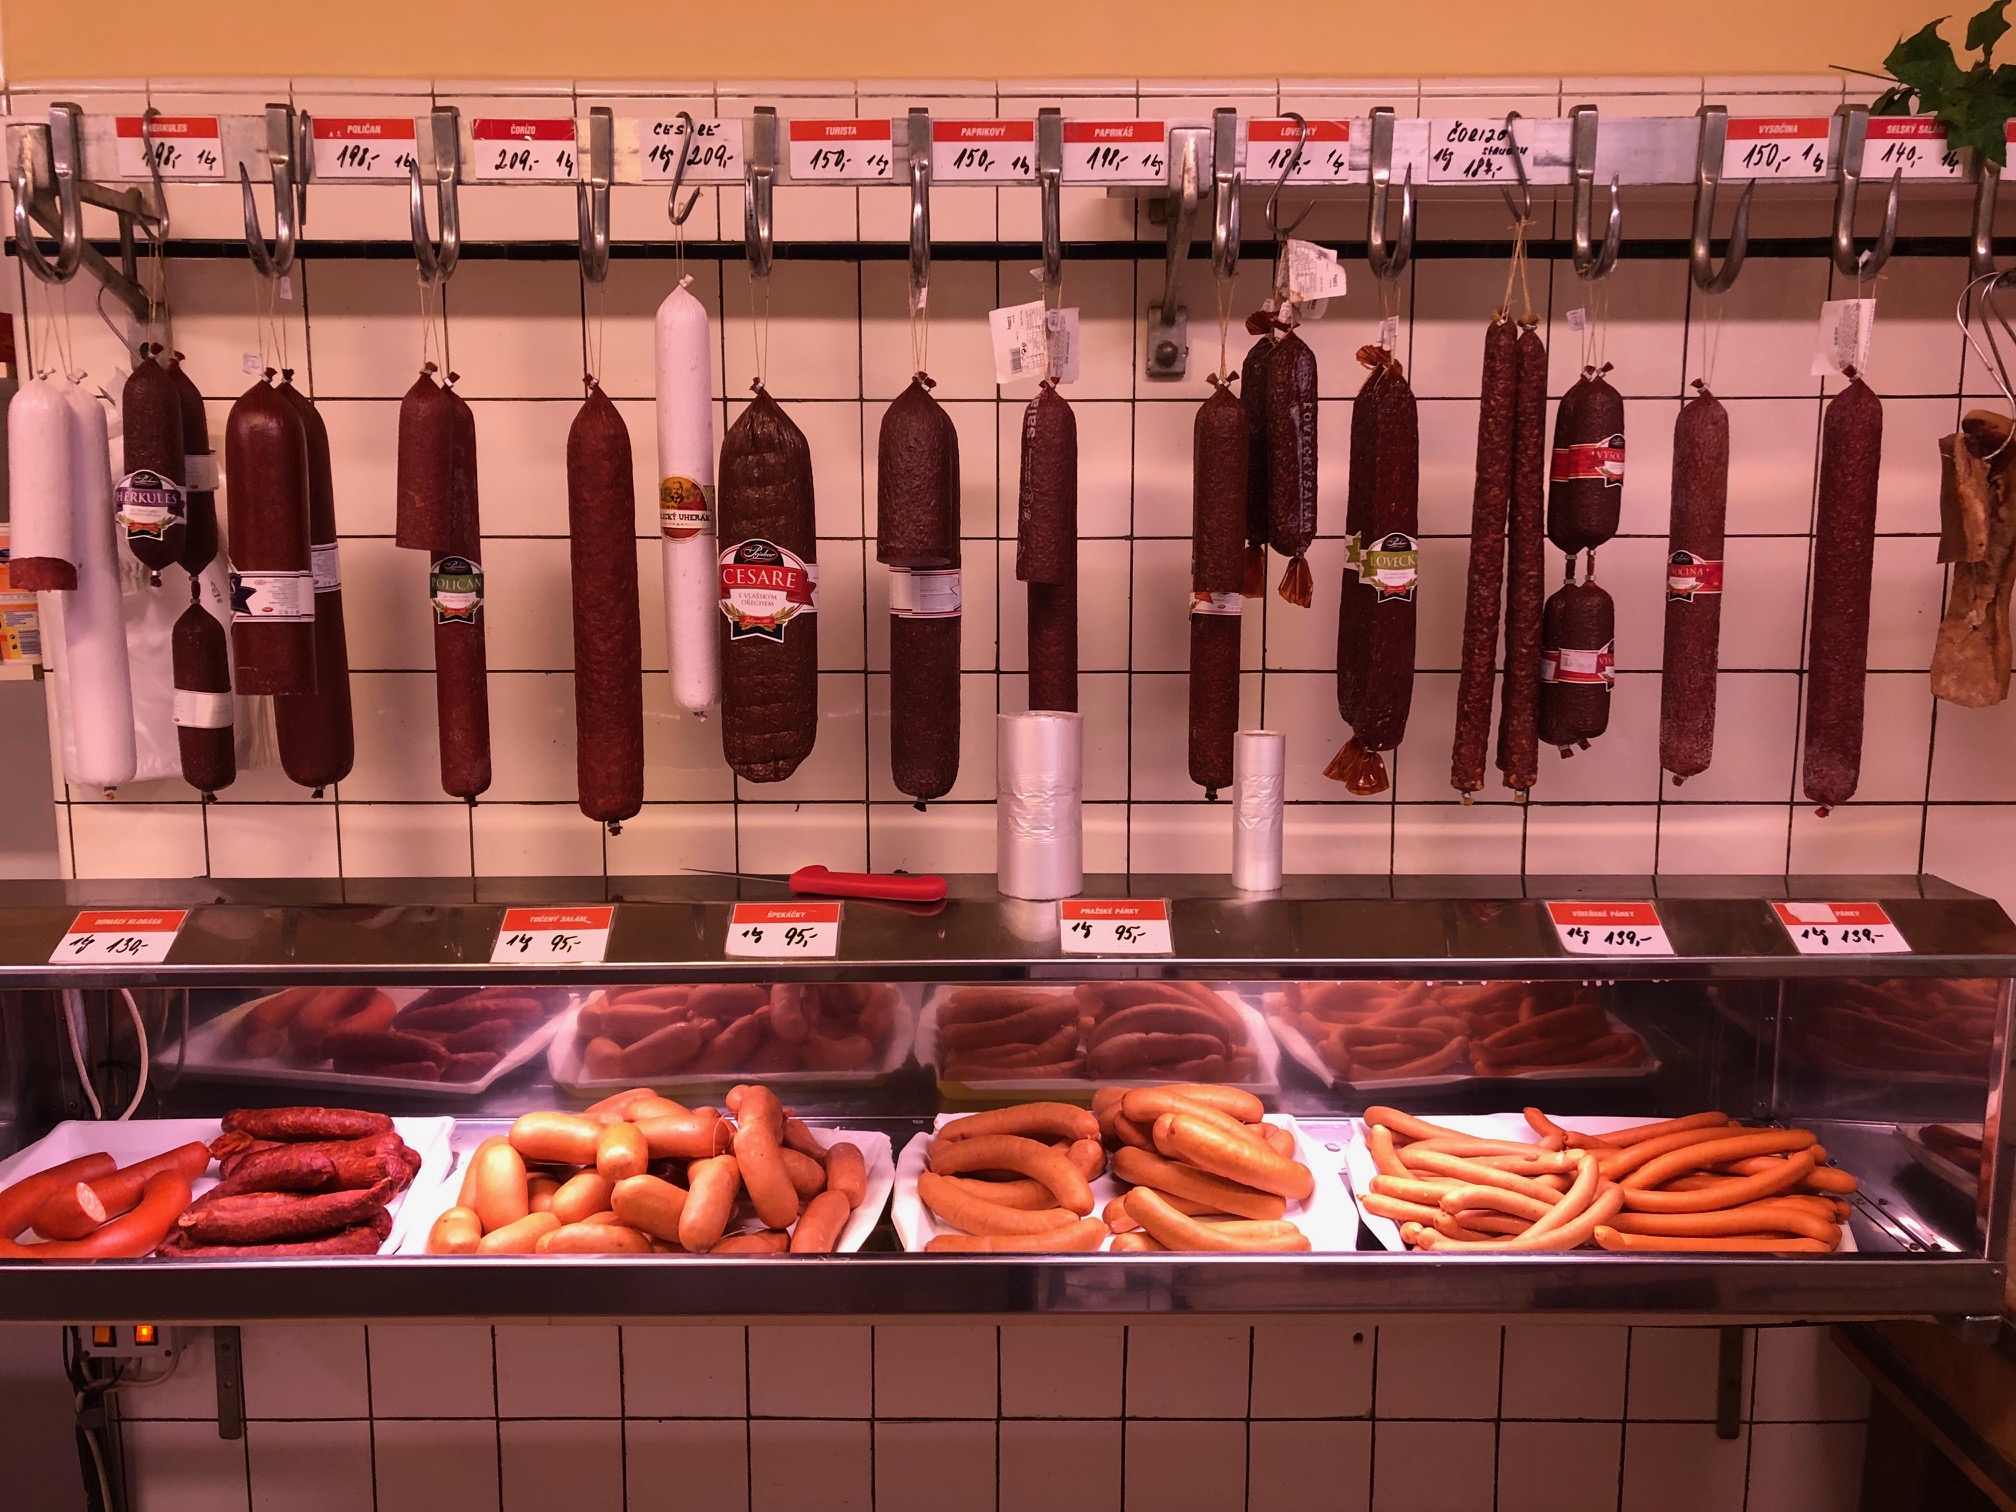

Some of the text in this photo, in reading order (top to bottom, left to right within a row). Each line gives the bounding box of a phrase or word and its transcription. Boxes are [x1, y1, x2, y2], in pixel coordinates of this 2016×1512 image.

[347, 123, 381, 134] POLIČAN
[653, 122, 721, 136] CESRE
[825, 126, 857, 136] TURISTA
[961, 125, 1007, 137] PAPRIKOVÝ
[1094, 127, 1134, 138] PAPRIKÁŠ
[1280, 125, 1317, 136] LOVEKÝ
[1758, 122, 1798, 134] VYSOČINA
[1886, 123, 1917, 134] SELSKÝ
[337, 144, 380, 171] 198,-
[686, 144, 733, 169] 209,-
[809, 148, 852, 172] 150,-
[953, 148, 995, 172] 150,-
[1742, 143, 1791, 173] 150,-
[1881, 142, 1923, 168] 140,-
[117, 491, 178, 504] HERKULES
[678, 512, 711, 521] UHERÁK
[723, 568, 797, 588] CESARE
[767, 911, 806, 919] ŠPEKÁČKY
[1080, 907, 1140, 915] PRAŽSKÉ PÁRKY
[1572, 909, 1635, 918] VÍDEŇSKÉ PÁRKY
[529, 915, 587, 923] TOČENÝ SALÁM
[785, 927, 818, 947] 95,-
[1115, 925, 1146, 944] 95,-
[1604, 931, 1652, 947] 139,-
[1841, 928, 1884, 944] 139,-
[106, 937, 149, 956] 130,-
[551, 934, 581, 953] 95,-
